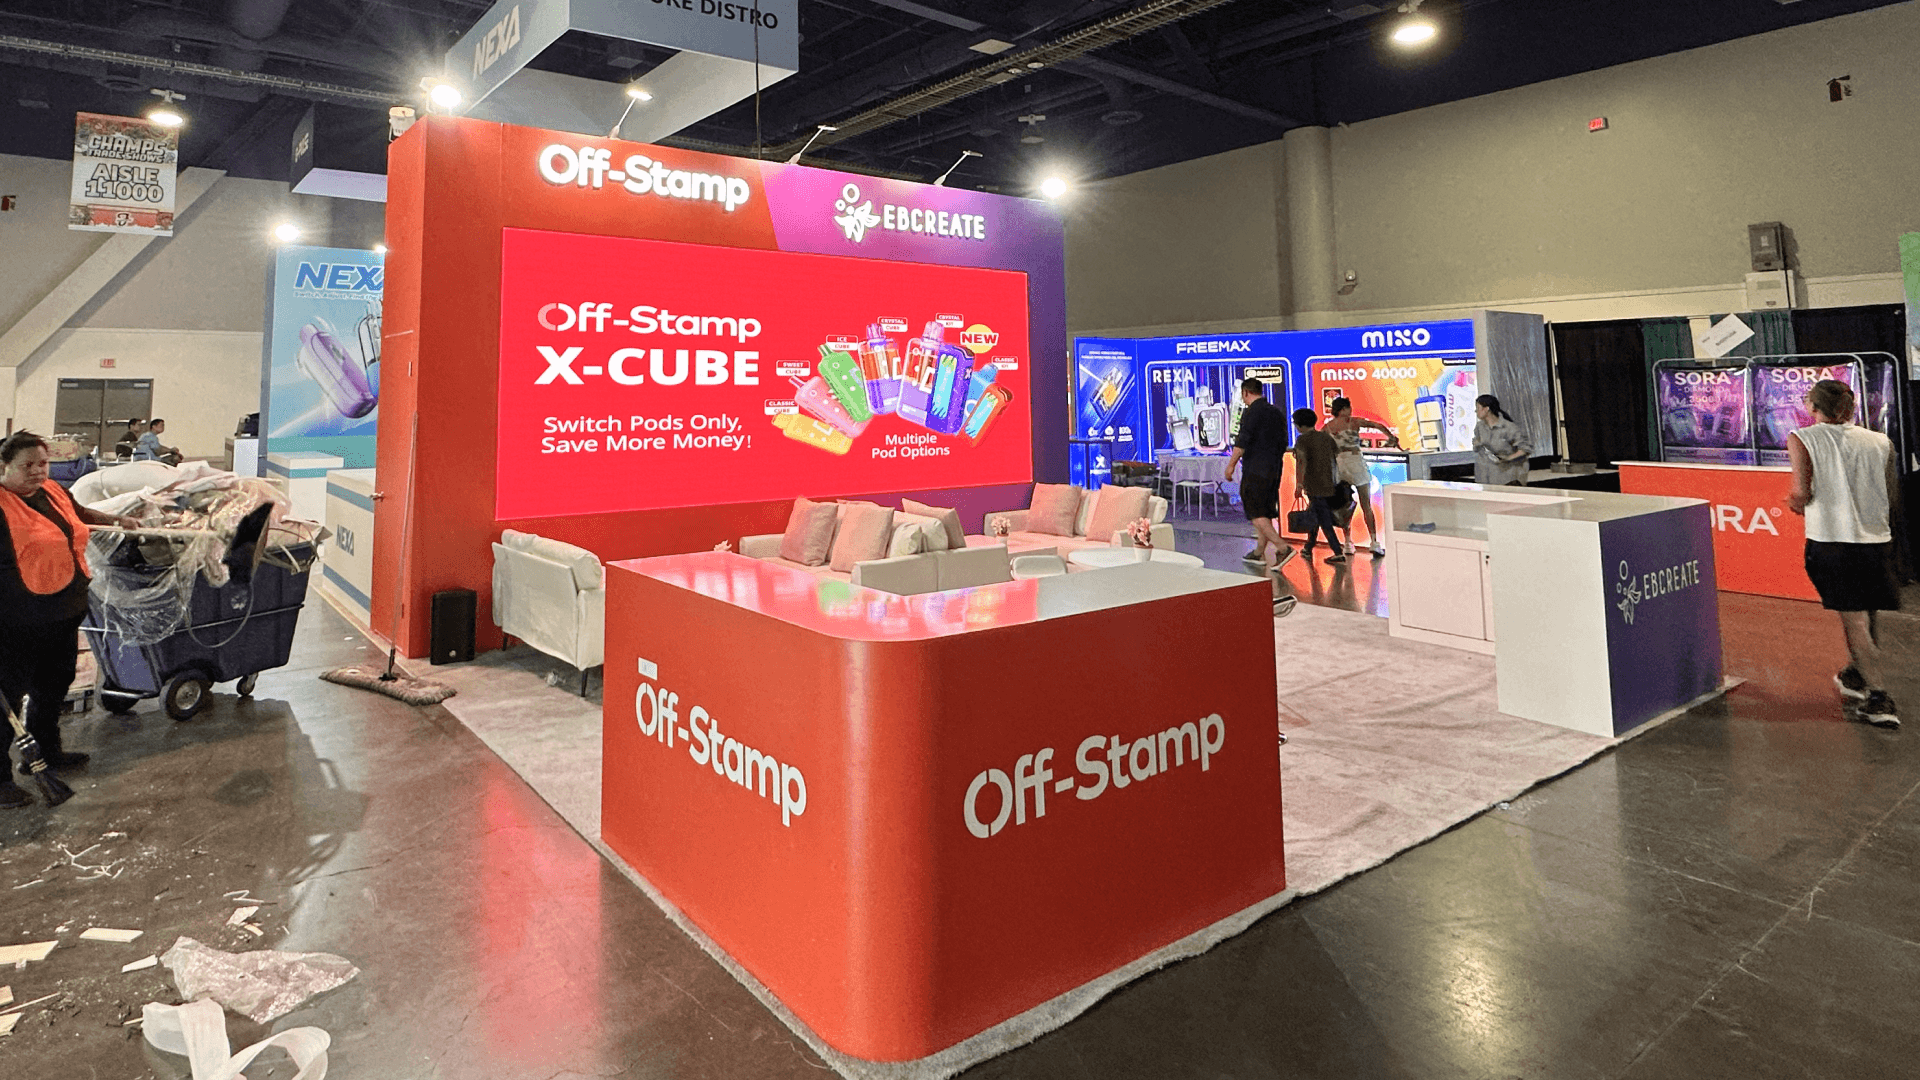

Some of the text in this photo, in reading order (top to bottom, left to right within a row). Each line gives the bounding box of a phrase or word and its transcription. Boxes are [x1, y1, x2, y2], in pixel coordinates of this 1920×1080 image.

[700, 0, 778, 29] DISTRO
[473, 5, 520, 81] NEXA
[88, 135, 167, 157] CHAMPS
[88, 149, 165, 164] TRADE SHOWS
[90, 163, 159, 185] AISLE
[538, 144, 750, 212] Off-Stamp
[85, 180, 164, 203] 11000
[883, 205, 986, 241] EBCREATE
[293, 261, 385, 292] NEX
[537, 301, 762, 343] Off-Stamp
[961, 333, 998, 344] NEW
[1176, 340, 1251, 354] FREEMAX
[533, 345, 759, 386] X-CUBE
[1152, 368, 1195, 383] REXA
[1371, 366, 1417, 380] 40000
[1771, 367, 1834, 383] SORA
[1674, 371, 1731, 385] SORA
[543, 413, 742, 433] Switch Pods Only,
[541, 433, 751, 453] Save More Money!
[885, 432, 938, 447] Multiple
[871, 446, 950, 460] Pod Options
[1643, 560, 1700, 600] EBCREATE
[635, 682, 808, 828] Off-Stamp
[963, 712, 1226, 839] Off-Stamp
